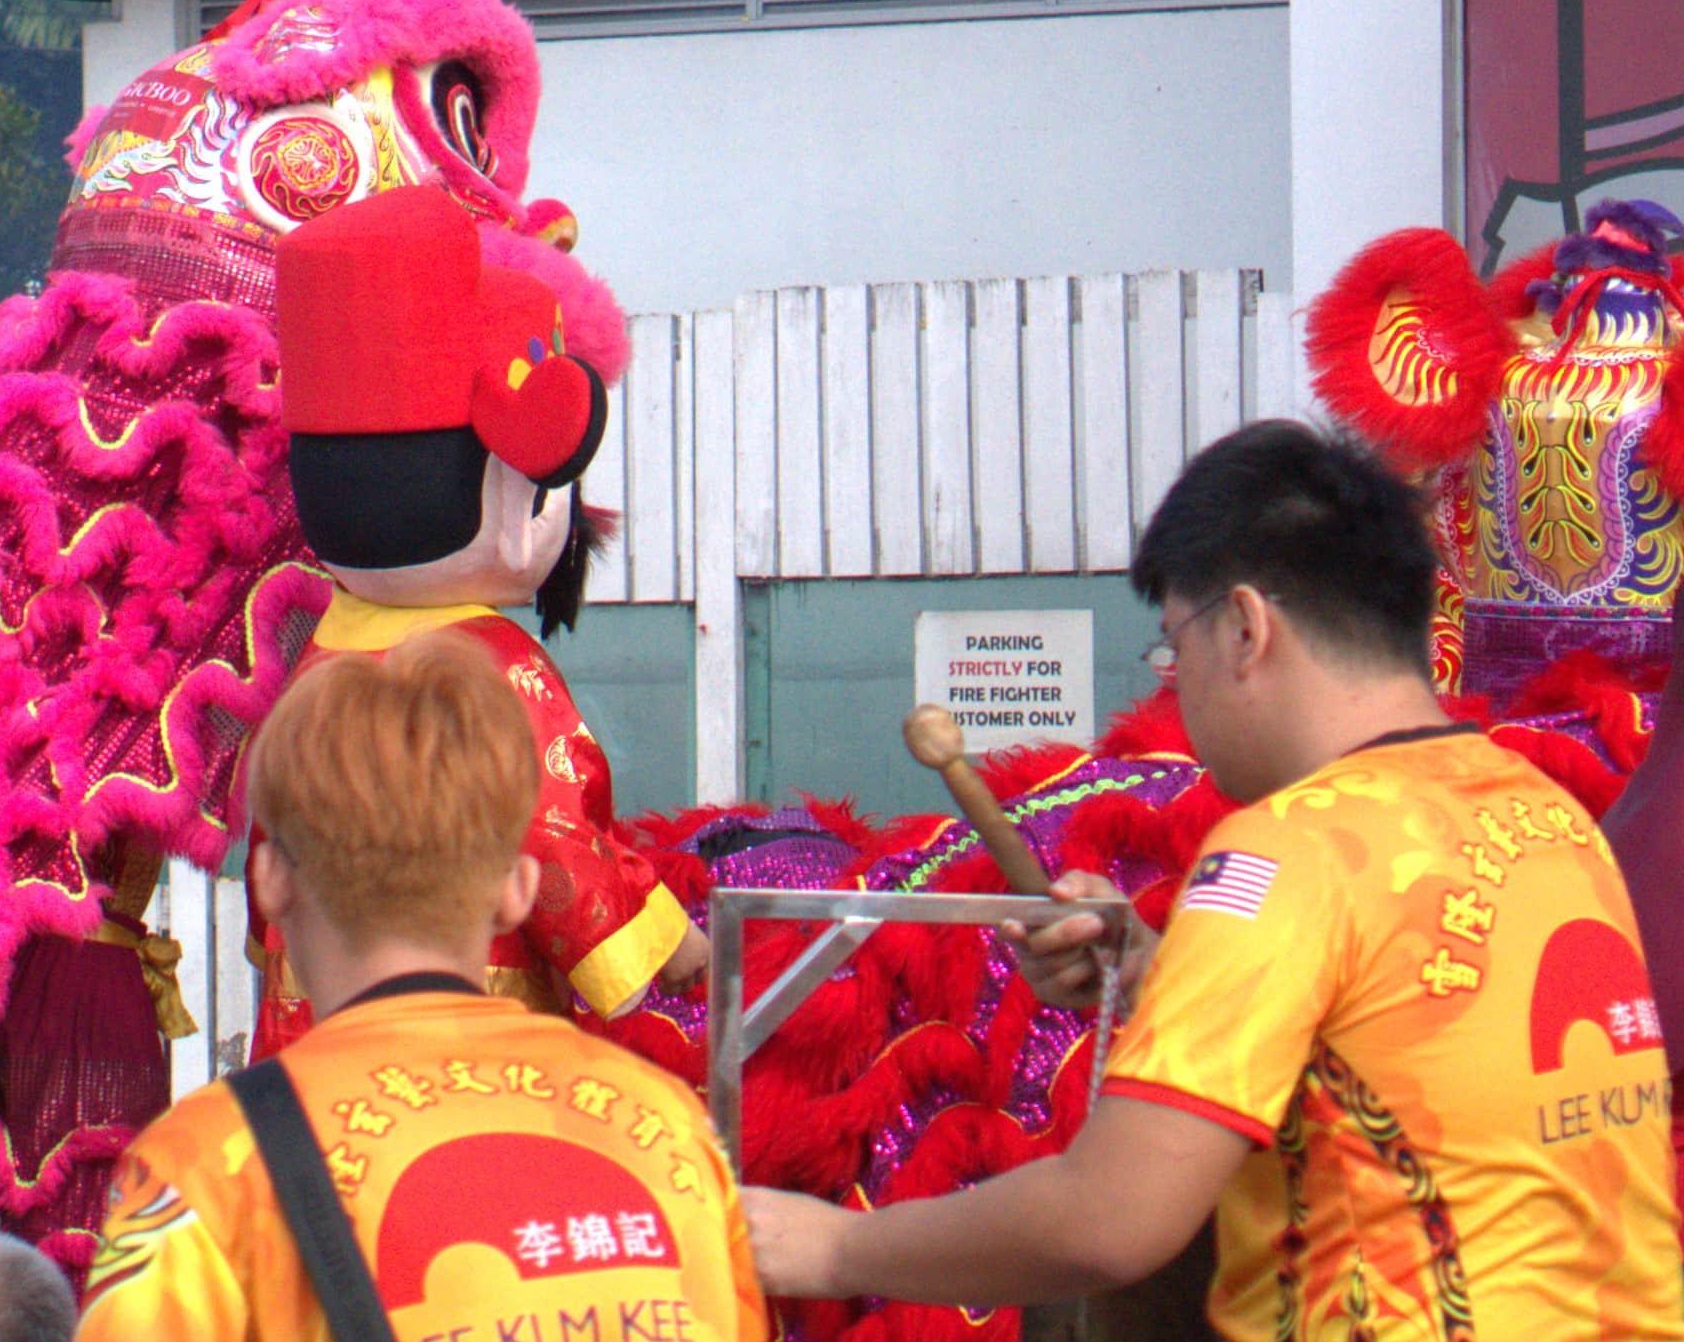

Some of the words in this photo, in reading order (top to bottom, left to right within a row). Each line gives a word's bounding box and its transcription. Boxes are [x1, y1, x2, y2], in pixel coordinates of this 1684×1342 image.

[966, 635, 1044, 651] PARKING
[948, 661, 1023, 676] STRICTLY
[1027, 661, 1062, 676] FOR
[948, 686, 986, 702] FIRE
[989, 686, 1062, 702] FIGHTER
[1028, 711, 1076, 727] ONLY
[1538, 1092, 1593, 1145] LEE
[1600, 1080, 1660, 1130] KUM
[512, 1211, 666, 1269] 李錦記
